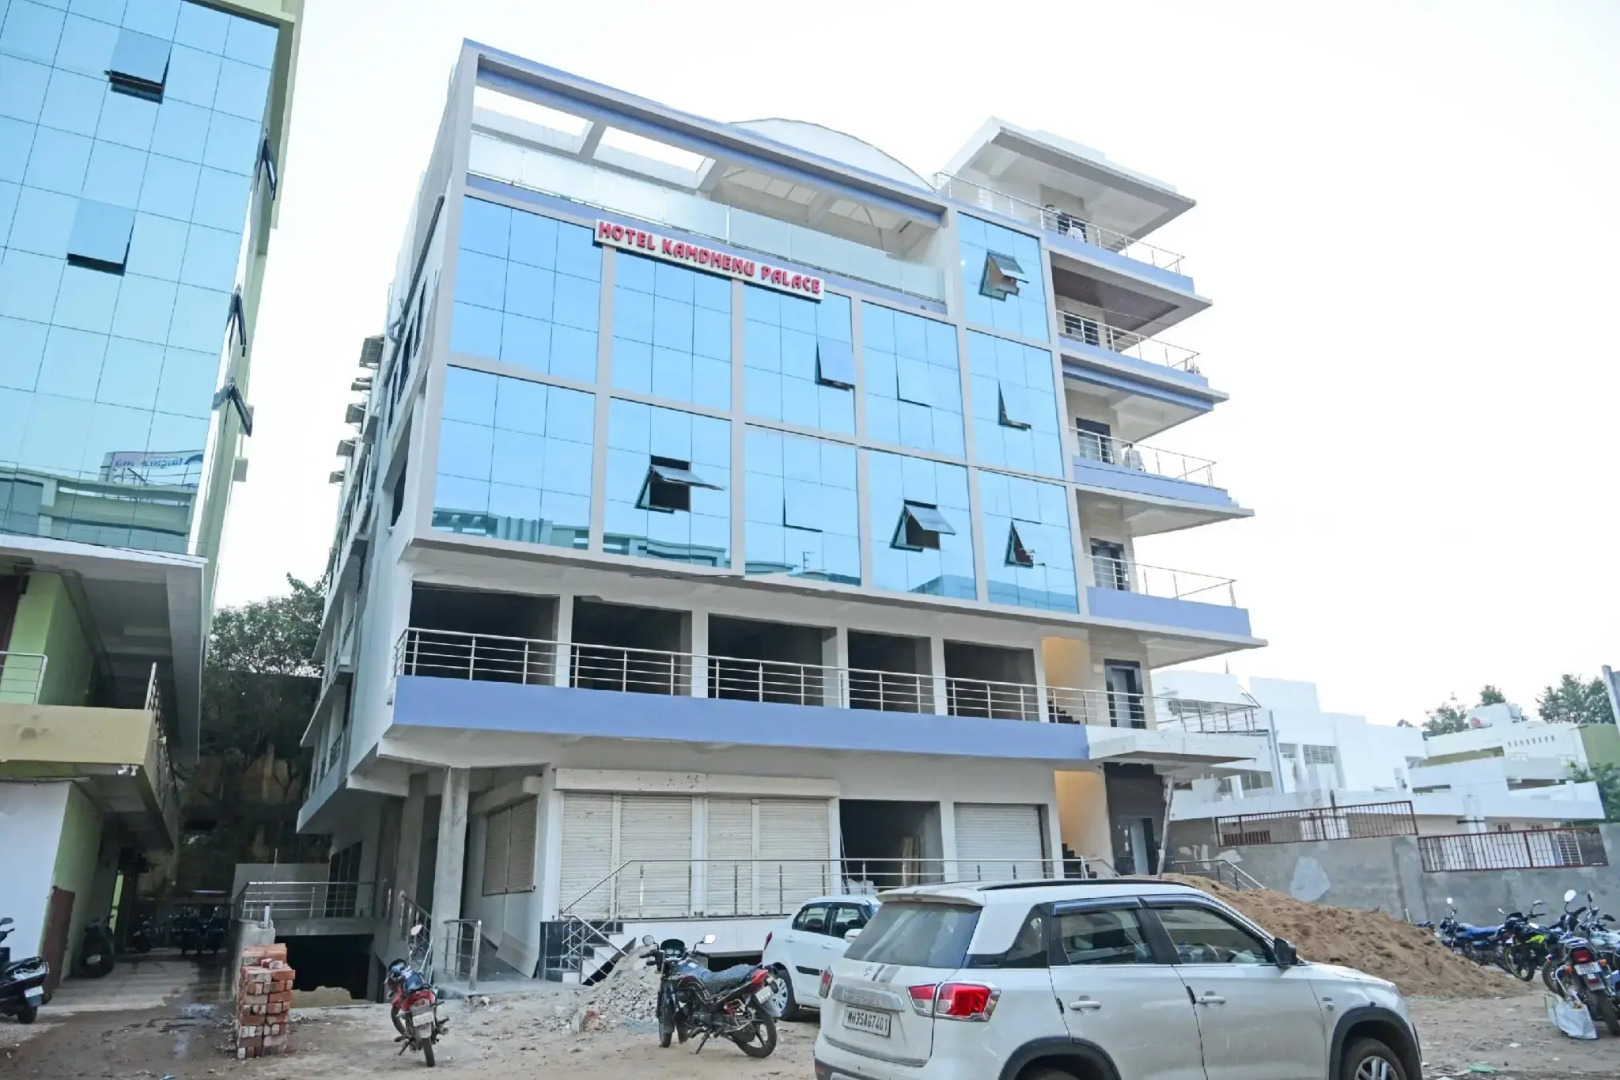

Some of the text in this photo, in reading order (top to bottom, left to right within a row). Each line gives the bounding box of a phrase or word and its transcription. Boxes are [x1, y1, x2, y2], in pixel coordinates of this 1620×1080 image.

[598, 221, 821, 294] HOTEL KAMDHENU PALACE
